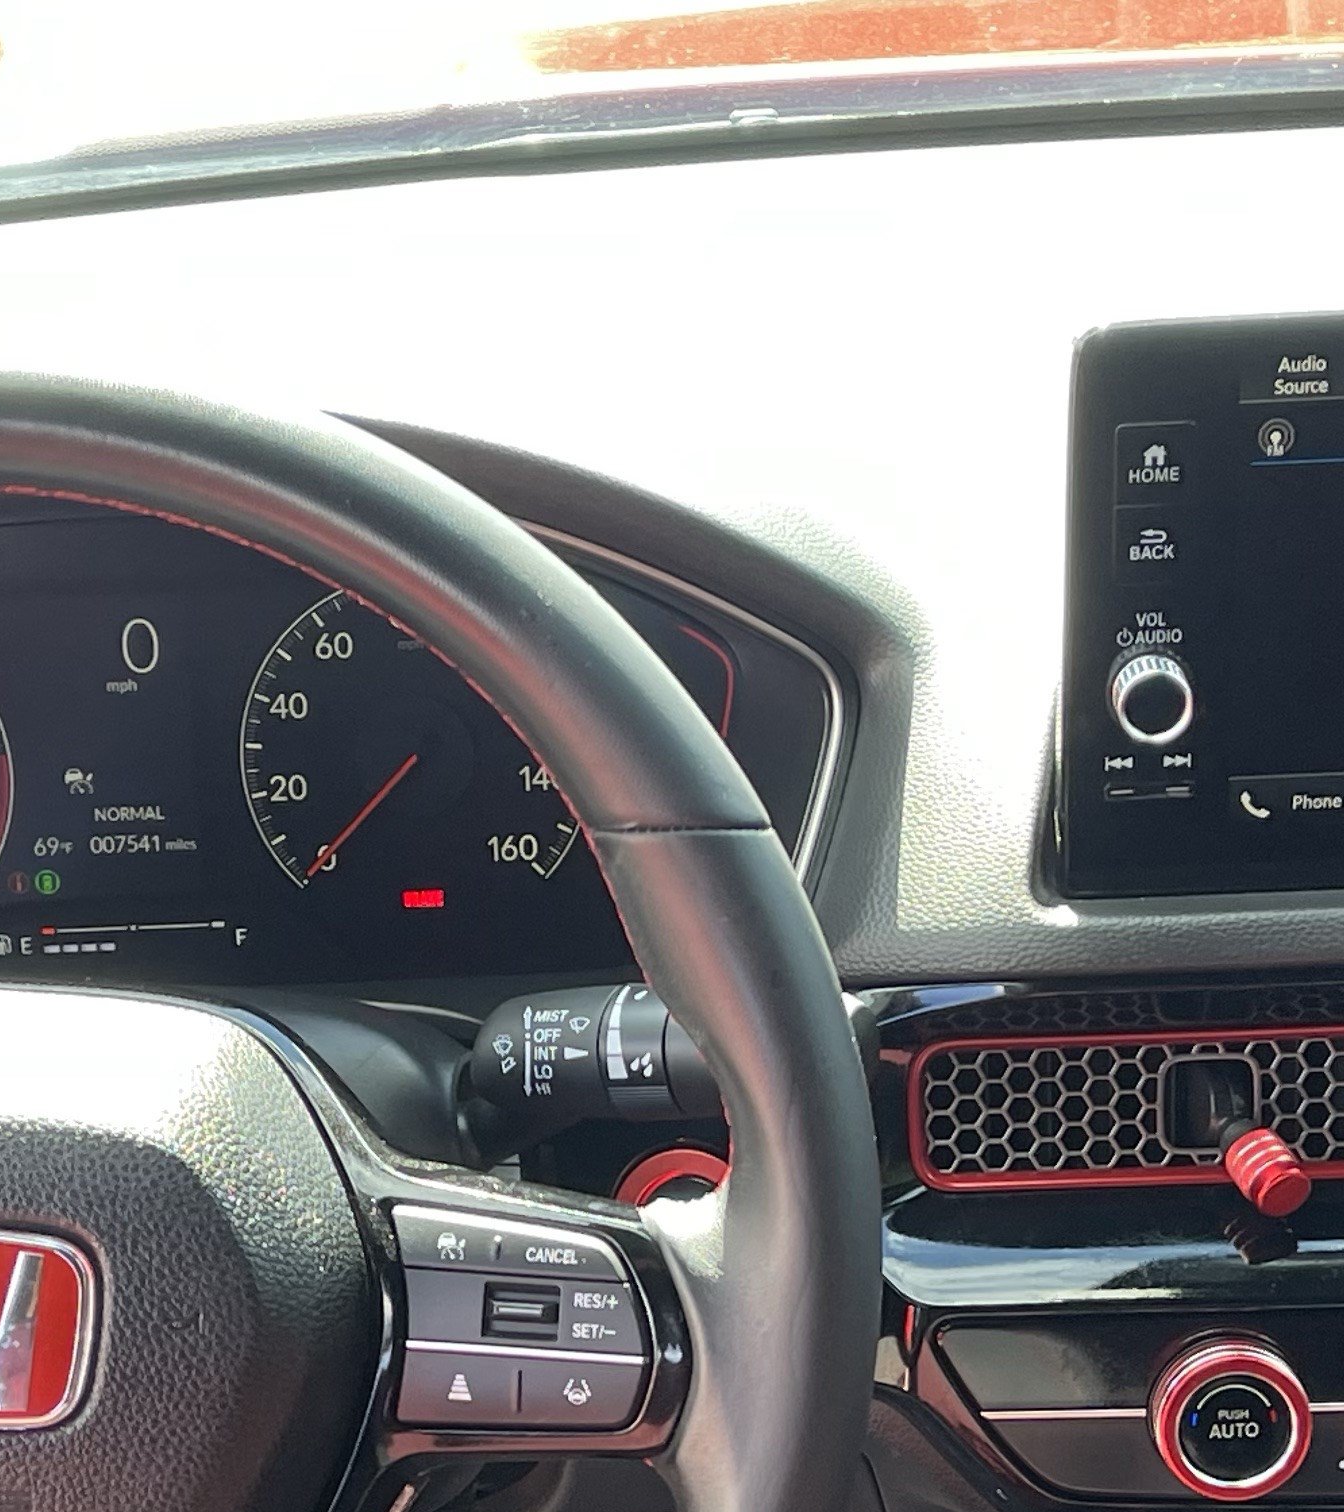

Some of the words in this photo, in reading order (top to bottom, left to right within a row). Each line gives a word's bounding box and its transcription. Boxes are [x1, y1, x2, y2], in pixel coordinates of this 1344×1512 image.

[1278, 355, 1327, 372] Audio
[1274, 378, 1329, 395] Source
[1128, 466, 1181, 484] HOME
[1129, 543, 1175, 562] BACK
[1135, 612, 1167, 628] VOL
[1134, 628, 1183, 644] AUDIO
[122, 617, 160, 674] 0
[315, 631, 354, 660] 60
[106, 678, 138, 695] mph
[269, 692, 308, 720] 40
[518, 765, 560, 792] 14
[269, 774, 307, 802] 20
[1292, 794, 1343, 810] Phone
[94, 805, 166, 822] NORMAL
[89, 835, 161, 854] 007541
[165, 837, 198, 851] miles
[487, 834, 538, 863] 160
[20, 936, 33, 956] E
[234, 927, 248, 947] F
[533, 1009, 570, 1022] MIST
[533, 1028, 562, 1044] OFF
[533, 1045, 558, 1061] INT
[533, 1064, 553, 1080] LO
[525, 1246, 579, 1265] CANCEL
[573, 1291, 619, 1311] RES/+
[1218, 1408, 1250, 1420] PUSH
[1208, 1422, 1260, 1440] AUTO
